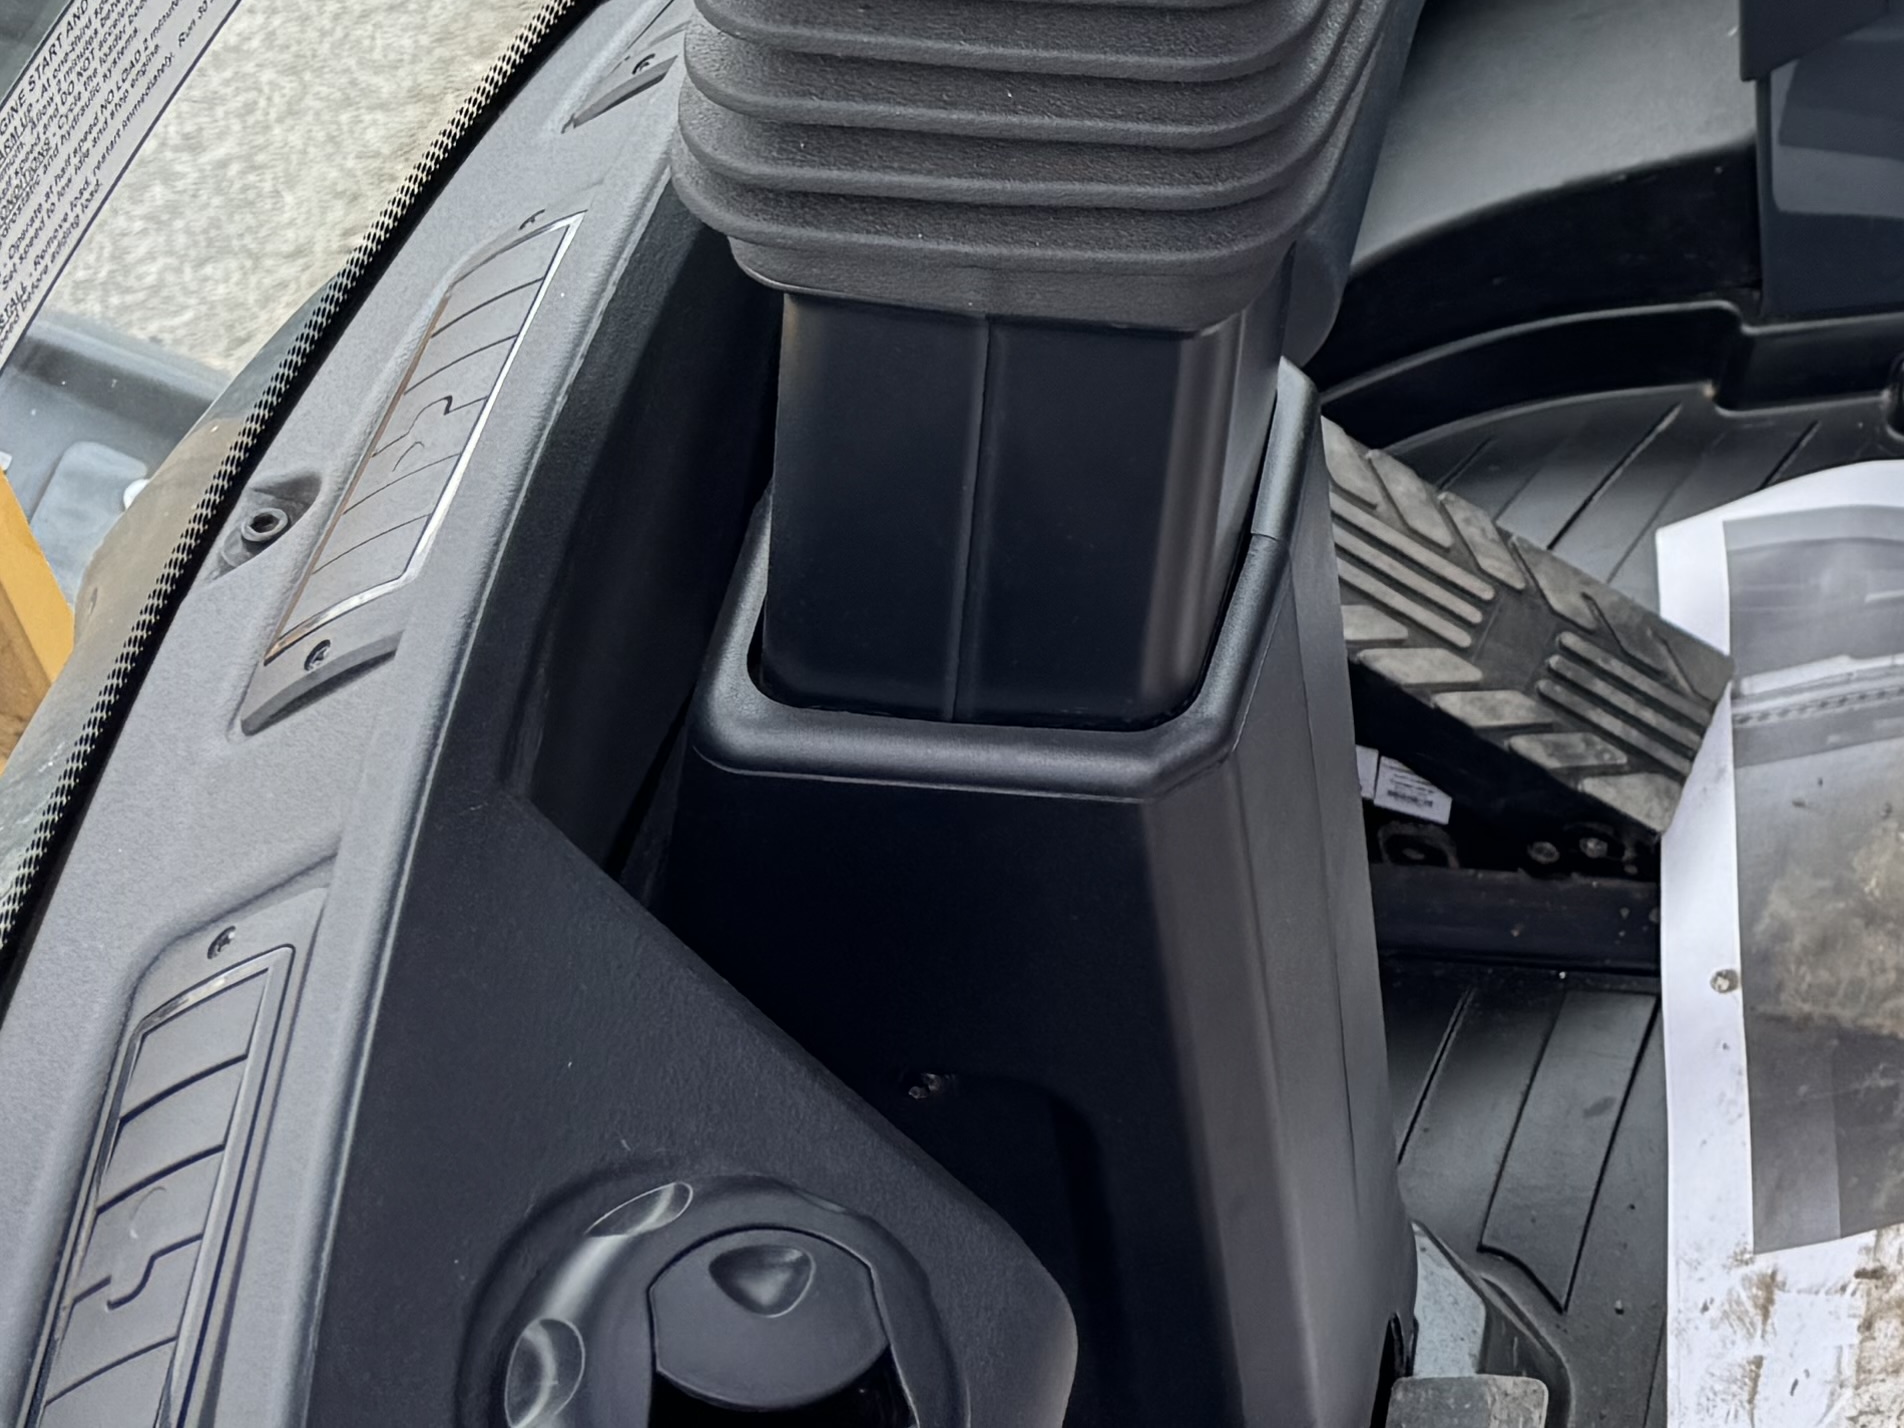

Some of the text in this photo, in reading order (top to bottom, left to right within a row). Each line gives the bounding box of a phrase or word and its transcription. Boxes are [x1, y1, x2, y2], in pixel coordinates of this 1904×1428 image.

[13, 129, 40, 181] speed
[41, 100, 59, 138] and
[59, 76, 75, 108] DO
[76, 45, 96, 84] NOT
[27, 30, 63, 96] START
[29, 88, 54, 135] Allow
[63, 24, 98, 84] minutes
[56, 86, 82, 135] Cycle
[82, 63, 98, 95] the
[98, 19, 127, 70] loader
[7, 198, 42, 263] Operate
[43, 181, 53, 206] at
[53, 151, 71, 188] half
[72, 110, 98, 162] speed
[99, 86, 114, 117] NO
[115, 45, 141, 94] LOAD
[18, 213, 45, 269] speed
[45, 197, 56, 222] to
[56, 172, 72, 204] low
[73, 143, 90, 177] idle
[91, 115, 108, 150] and
[109, 86, 129, 123] stop
[32, 208, 68, 273] Remove
[92, 125, 121, 180] restart
[177, 15, 195, 49] Run
[41, 140, 59, 178] and
[59, 76, 101, 150] hydraulic
[49, 209, 80, 266] adding
